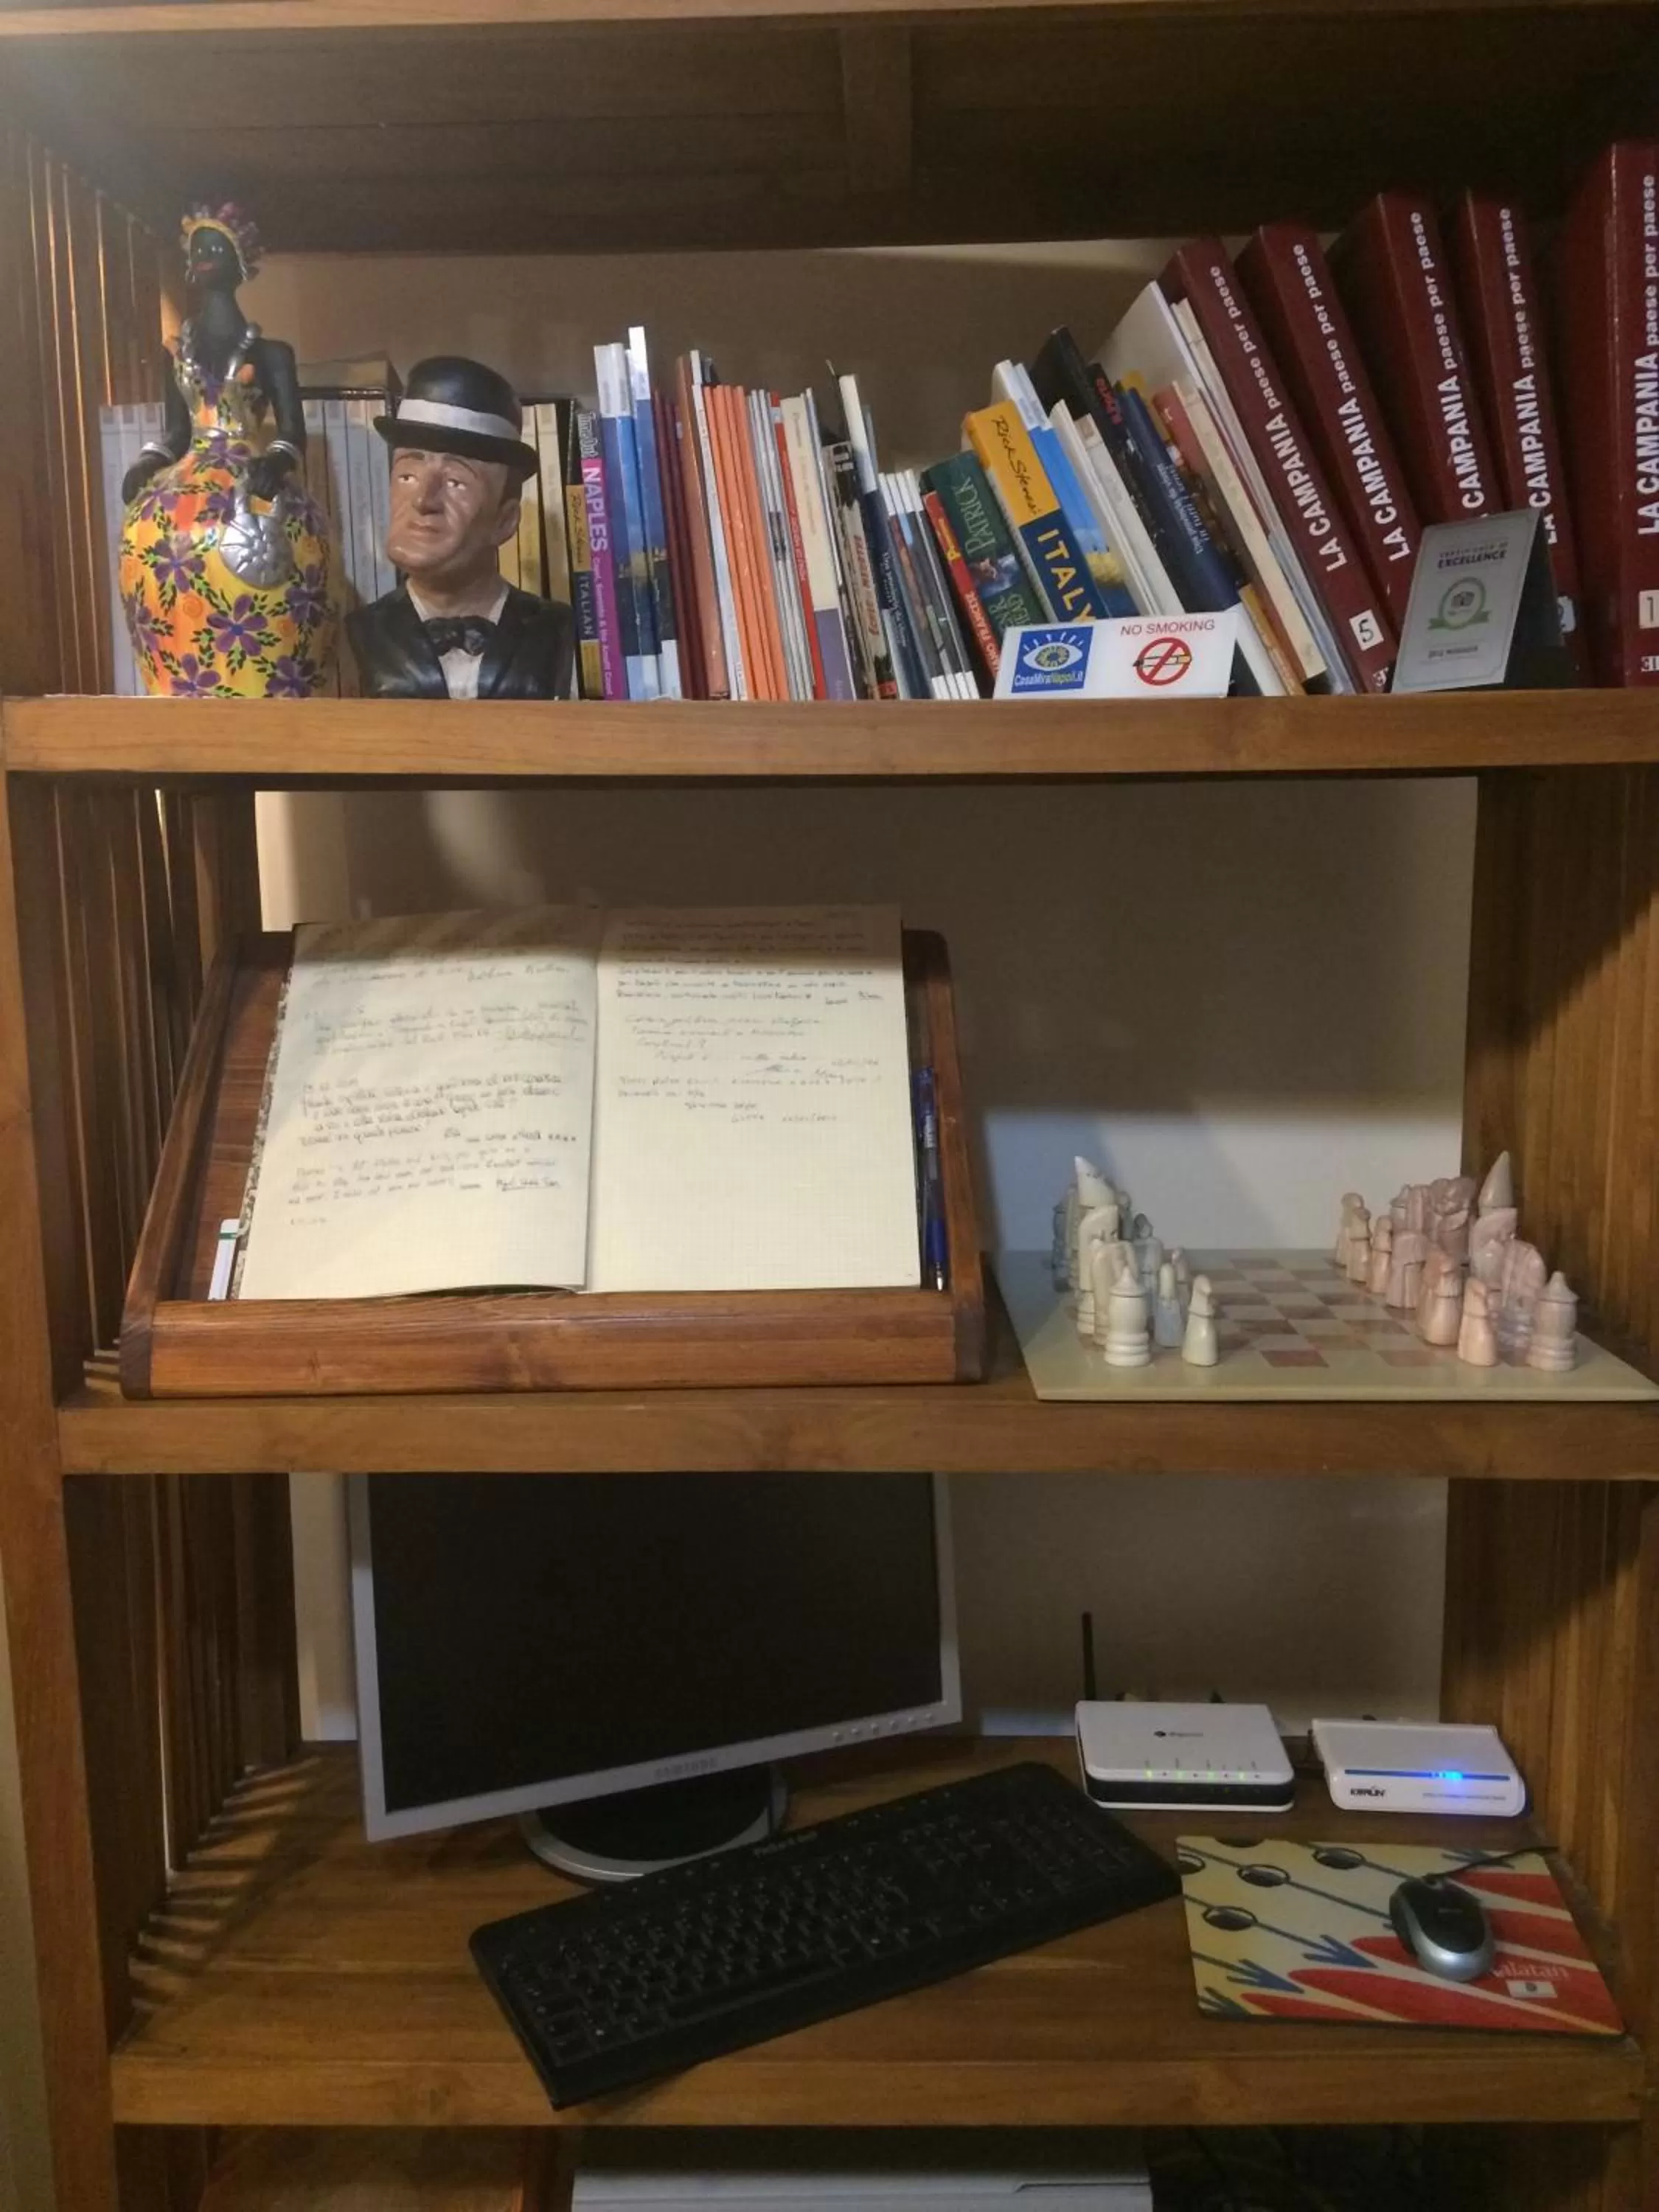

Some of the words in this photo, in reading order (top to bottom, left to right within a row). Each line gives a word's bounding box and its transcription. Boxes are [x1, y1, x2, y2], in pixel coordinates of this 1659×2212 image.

[1643, 175, 1659, 237] paese
[1411, 212, 1435, 270] paese
[1500, 208, 1520, 266] paese
[1645, 243, 1659, 277] per
[1210, 265, 1242, 319] paese
[1293, 244, 1322, 299] paese
[1425, 275, 1443, 307] per
[1509, 272, 1526, 305] per
[1234, 322, 1257, 354] per
[1314, 304, 1335, 335] per
[1434, 313, 1457, 369] paese
[1515, 311, 1534, 369] paese
[1645, 285, 1659, 346] paese
[1251, 357, 1281, 409] paese
[1326, 339, 1356, 394] paese
[1437, 375, 1485, 508] CAMPANIA
[1513, 374, 1551, 508] CAMPANIA
[1635, 352, 1659, 494] CAMPANIA
[1265, 413, 1332, 538] CAMPANIA
[1337, 397, 1397, 525] CAMPANIA
[582, 467, 608, 552] NAPLES
[954, 476, 997, 557] PATRICK
[1637, 501, 1659, 535] LA
[1318, 536, 1347, 571] LA
[1382, 526, 1411, 561] LA
[1438, 549, 1508, 569] EXCELLENCE
[1037, 529, 1097, 623] ITALY
[580, 575, 594, 635] ITALIAN
[1120, 625, 1143, 636] NO
[1145, 619, 1216, 635] SMOKING
[1359, 618, 1374, 643] 5
